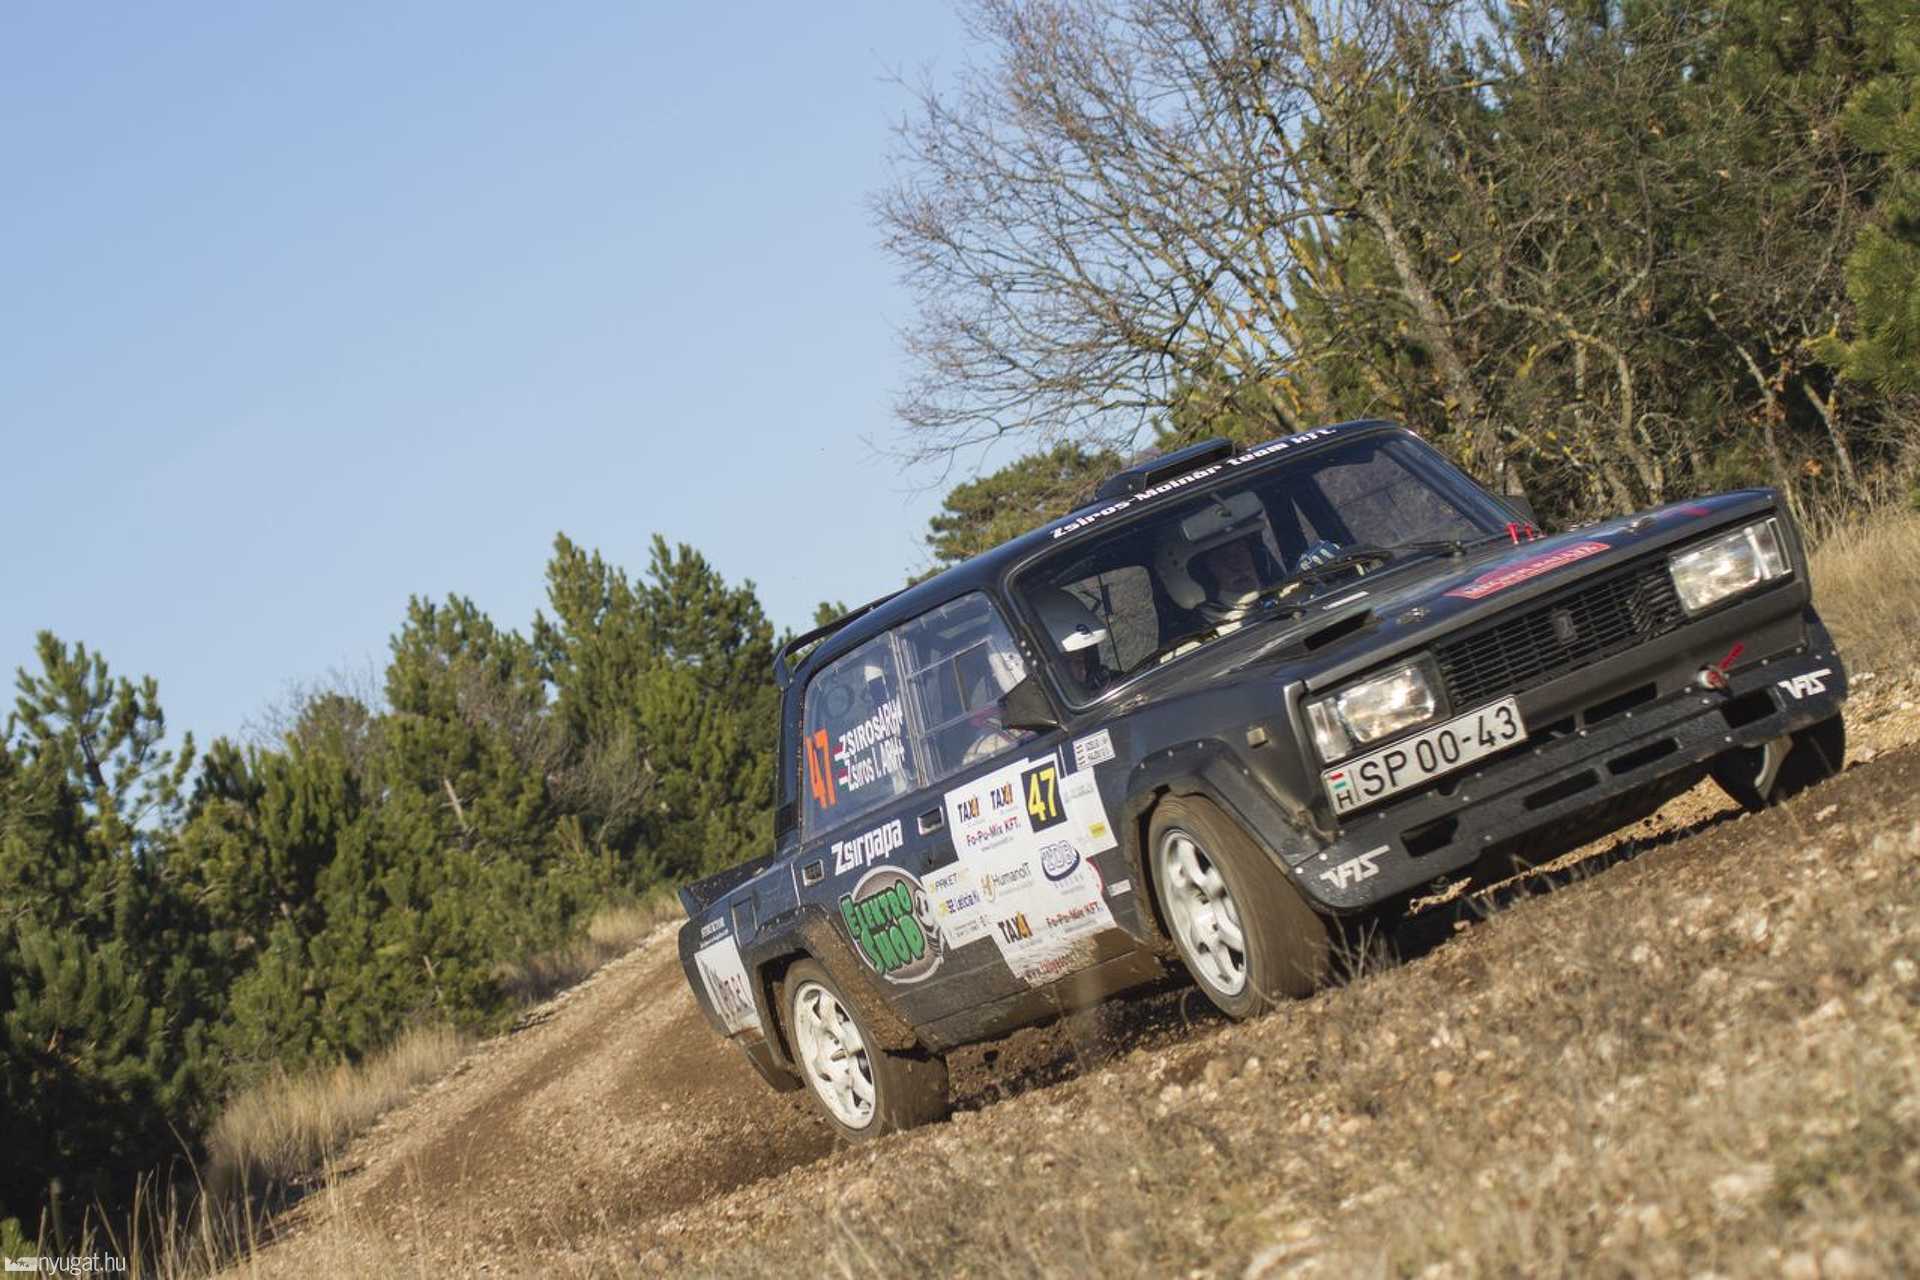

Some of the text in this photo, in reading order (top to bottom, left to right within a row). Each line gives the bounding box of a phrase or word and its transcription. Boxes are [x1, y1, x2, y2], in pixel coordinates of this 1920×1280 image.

[804, 728, 837, 809] 47
[1028, 767, 1058, 821] 47
[1336, 790, 1355, 809] H
[831, 819, 904, 876] Zsirpapa
